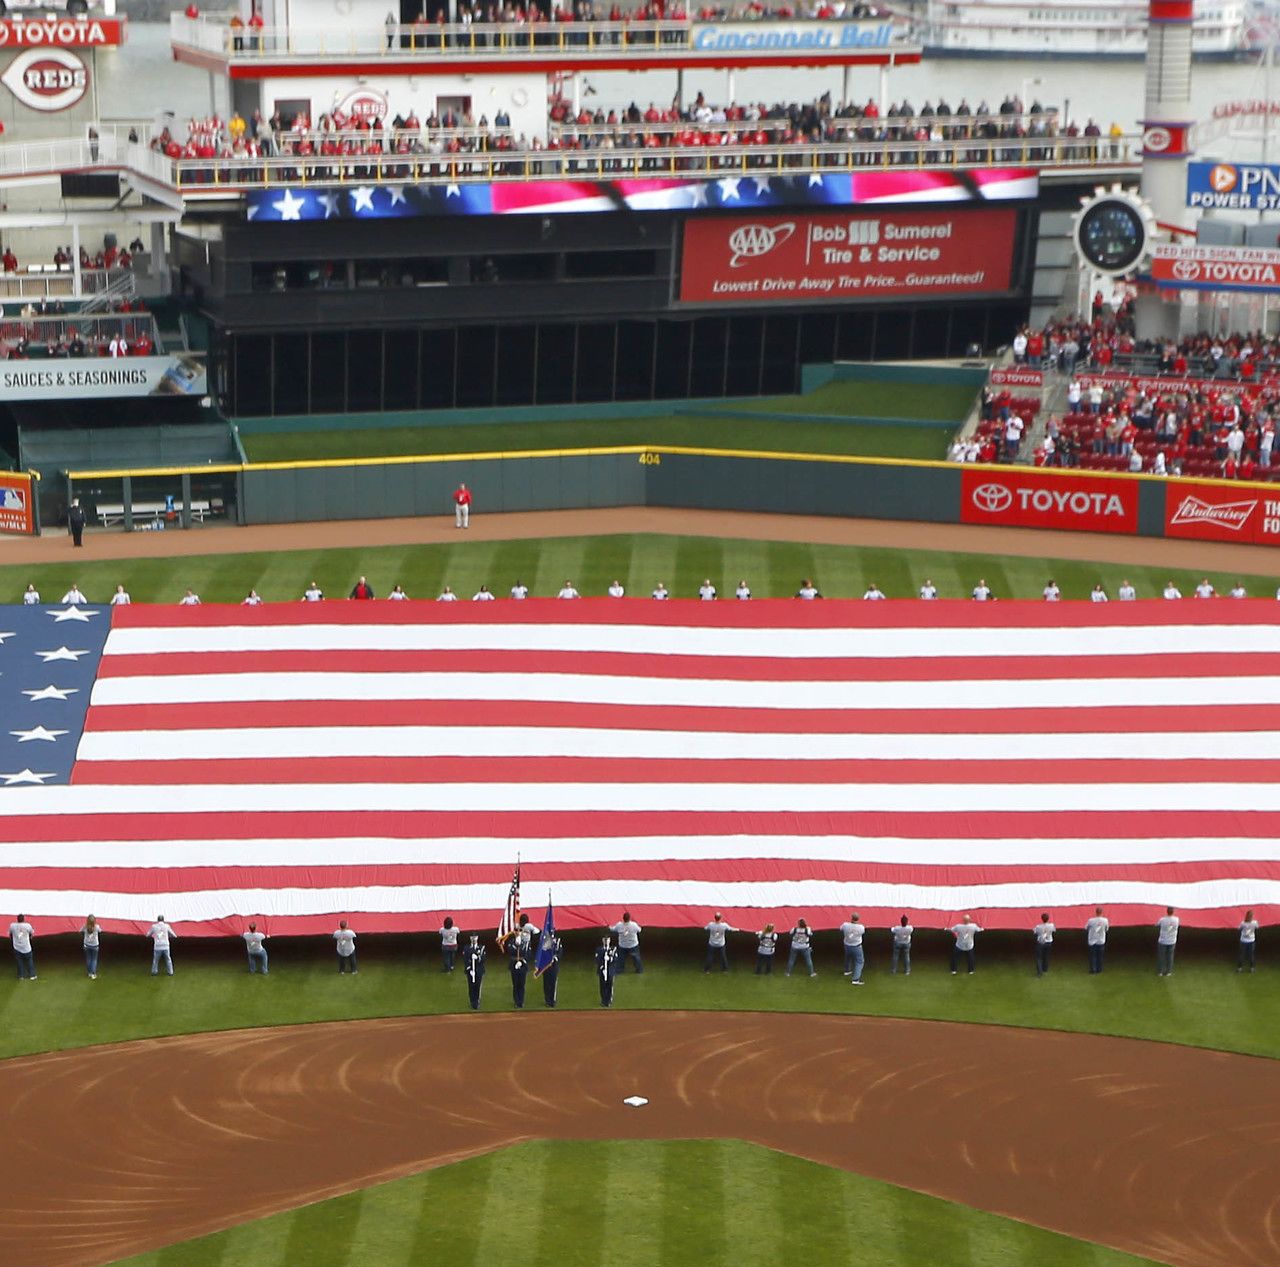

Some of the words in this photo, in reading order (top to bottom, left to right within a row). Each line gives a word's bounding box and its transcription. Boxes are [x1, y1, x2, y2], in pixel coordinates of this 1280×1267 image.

[12, 22, 106, 43] TOYOTA
[838, 24, 894, 48] Bell
[25, 69, 86, 88] REDS
[1190, 192, 1251, 208] POWER
[731, 227, 775, 252] AAA
[812, 226, 846, 242] Bob
[884, 222, 952, 240] Sumerel
[823, 248, 852, 264] Tire
[859, 248, 872, 262] &
[877, 245, 940, 262] Service
[1204, 263, 1277, 281] TOYOTA
[713, 279, 759, 293] Lowest
[761, 278, 796, 291] Drive
[798, 277, 835, 293] Away
[838, 275, 861, 288] Tire
[4, 372, 54, 388] SAUCES
[56, 372, 65, 386] &
[68, 370, 148, 386] SEASONINGS
[1006, 374, 1042, 384] TOYOTA
[637, 453, 661, 466] 404
[1016, 488, 1125, 516] TOYOTA
[1180, 500, 1249, 522] Budweiser
